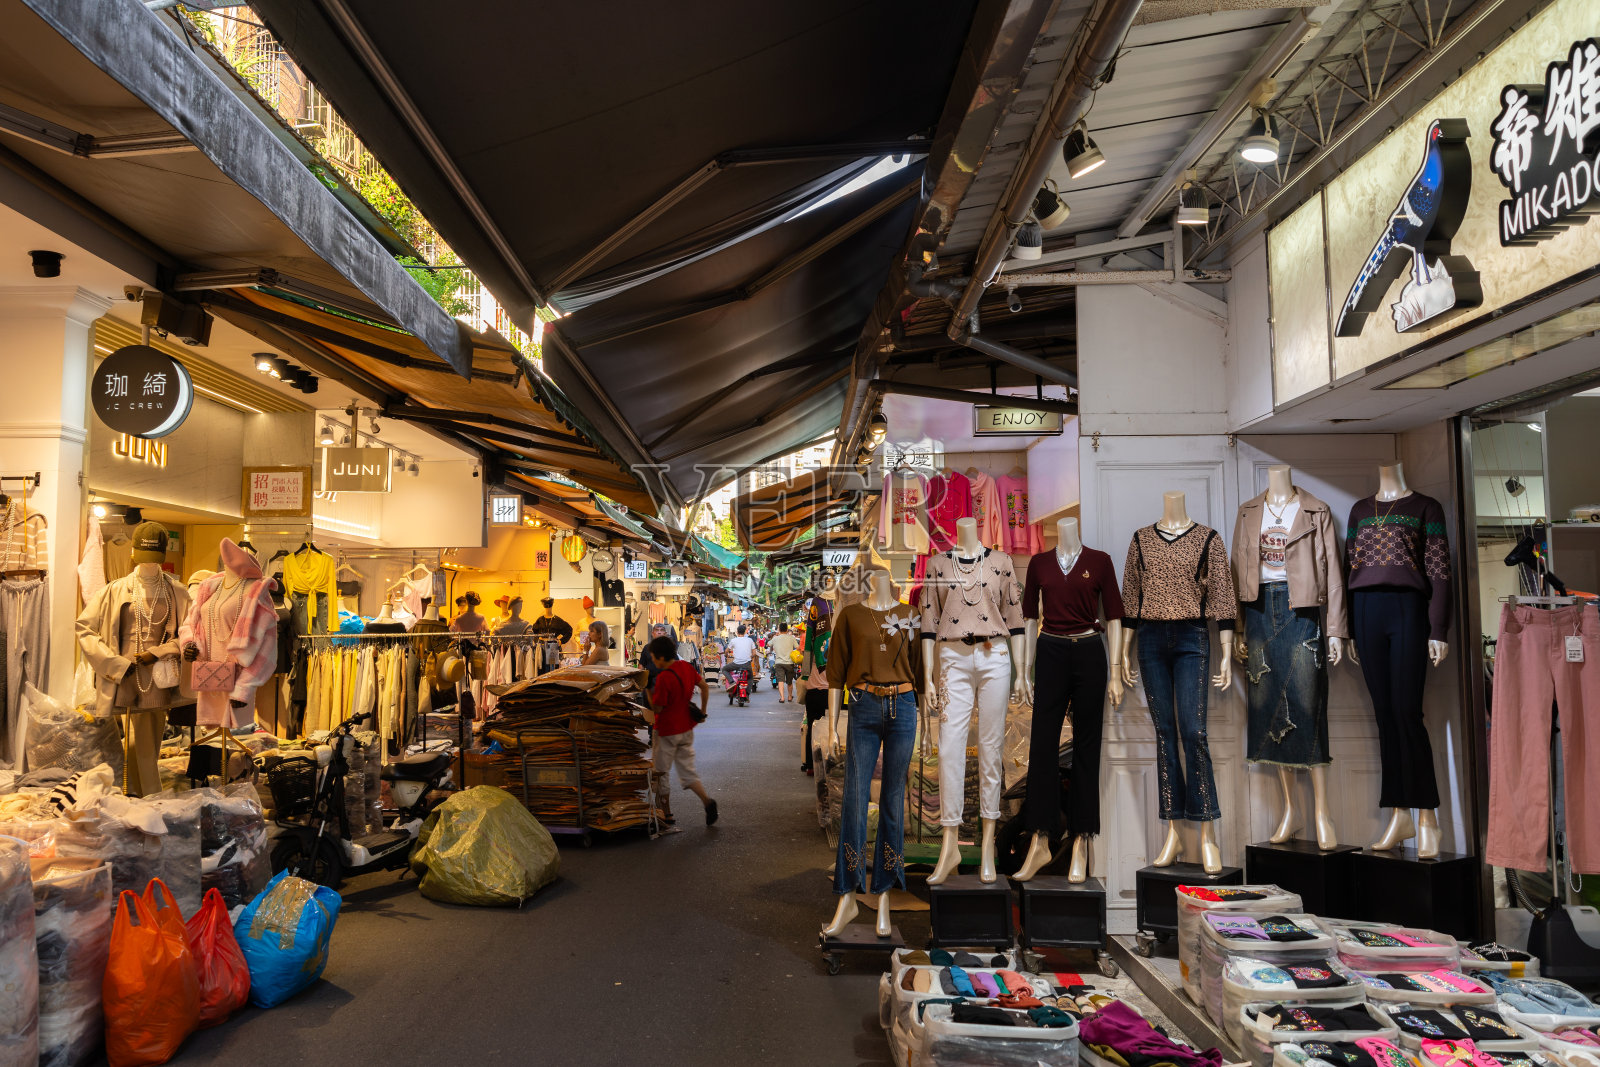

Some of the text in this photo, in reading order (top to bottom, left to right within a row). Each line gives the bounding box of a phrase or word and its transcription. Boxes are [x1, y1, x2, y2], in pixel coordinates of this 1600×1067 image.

[104, 371, 167, 397] 珈綺
[129, 402, 163, 410] CREW
[992, 412, 1048, 426] ENJOY
[112, 433, 169, 468] JUNI
[333, 461, 380, 476] JUNI
[253, 474, 269, 507] 招聘
